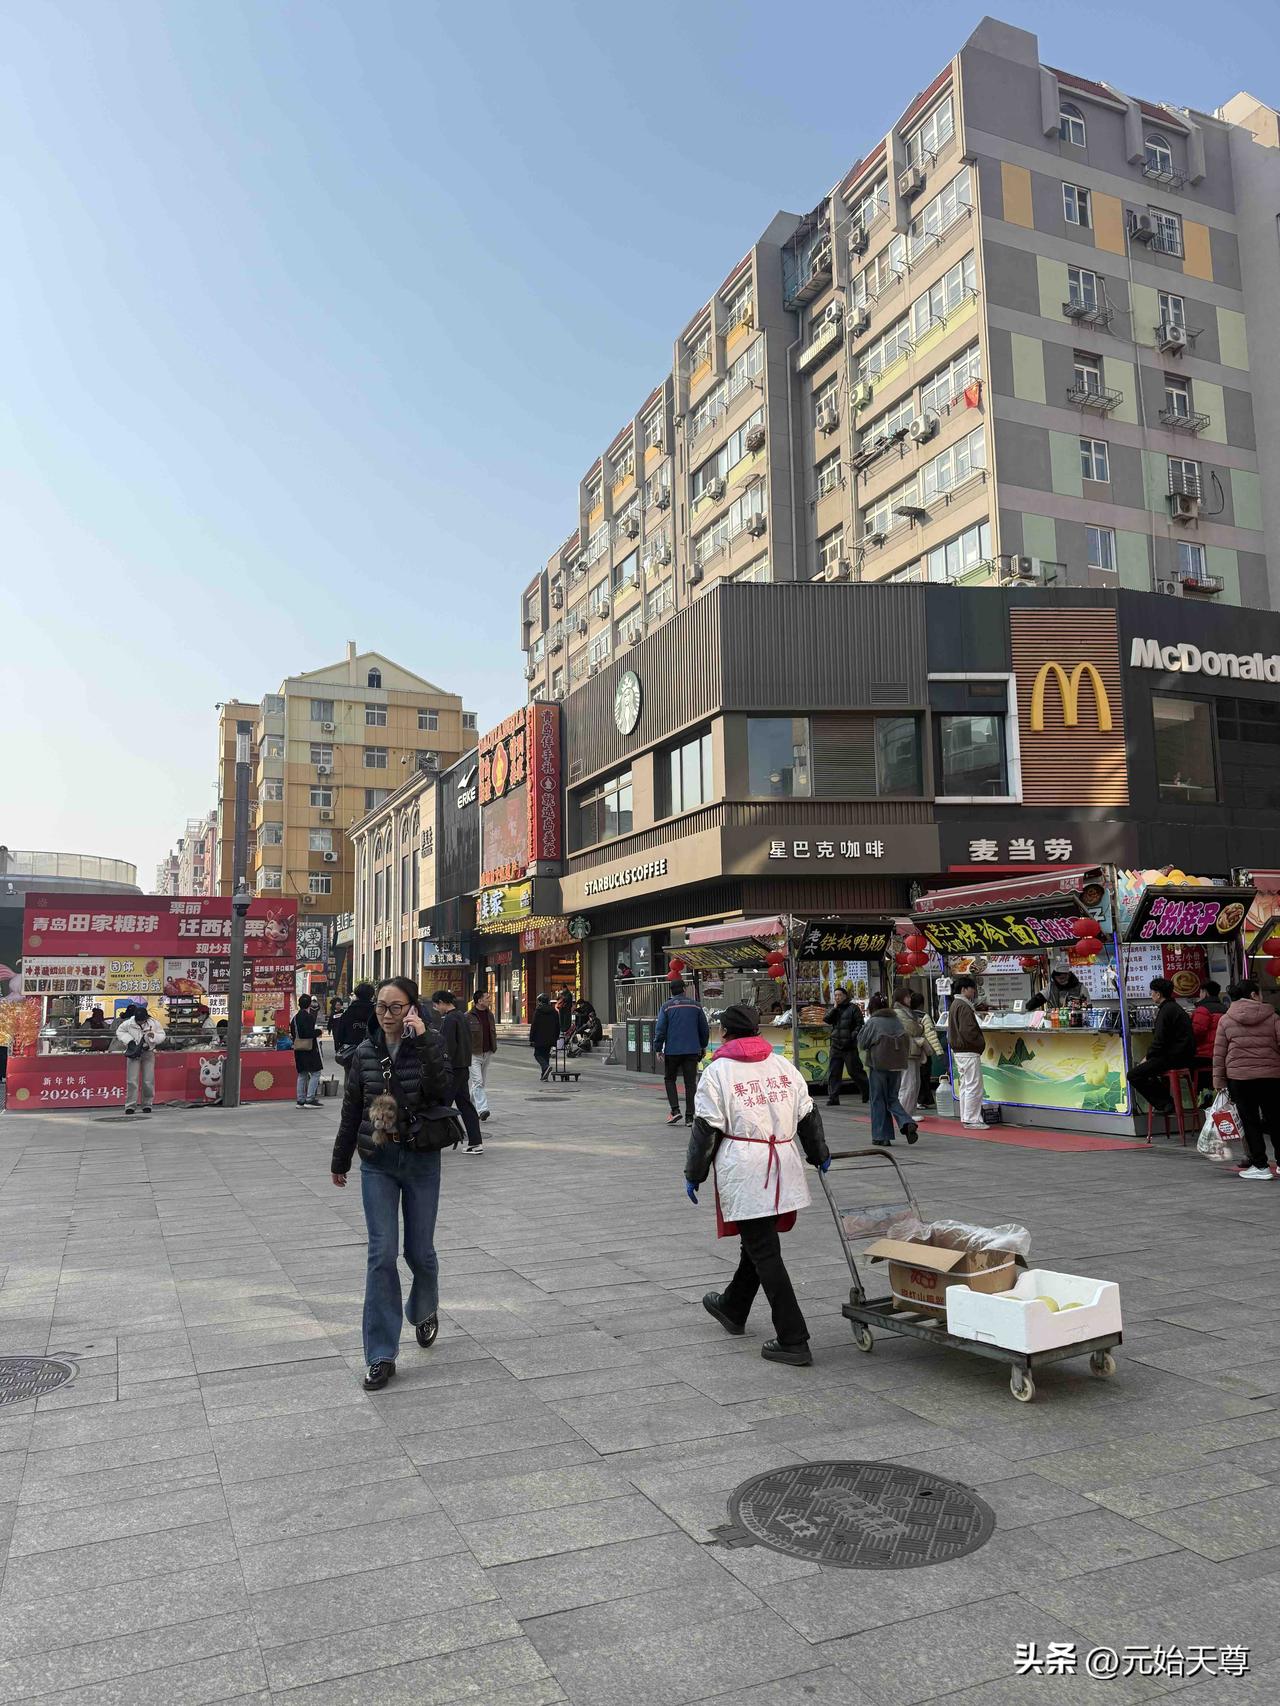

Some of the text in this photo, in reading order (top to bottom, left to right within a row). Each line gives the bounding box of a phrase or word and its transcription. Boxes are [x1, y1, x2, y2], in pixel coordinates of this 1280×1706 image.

[458, 787, 476, 809] ERKE
[769, 840, 885, 858] 星巴克咖啡
[969, 838, 1072, 861] 麦当劳
[584, 859, 667, 895] STARBUCKS COFFEE
[32, 914, 159, 932] 青岛田家糖球
[805, 928, 886, 955] 老六 铁板鸭肠
[43, 1076, 87, 1086] 新年快乐
[766, 1074, 792, 1089] 板栗
[40, 1086, 127, 1100] 2026年马年
[744, 1090, 789, 1107] 冰糖葫芦
